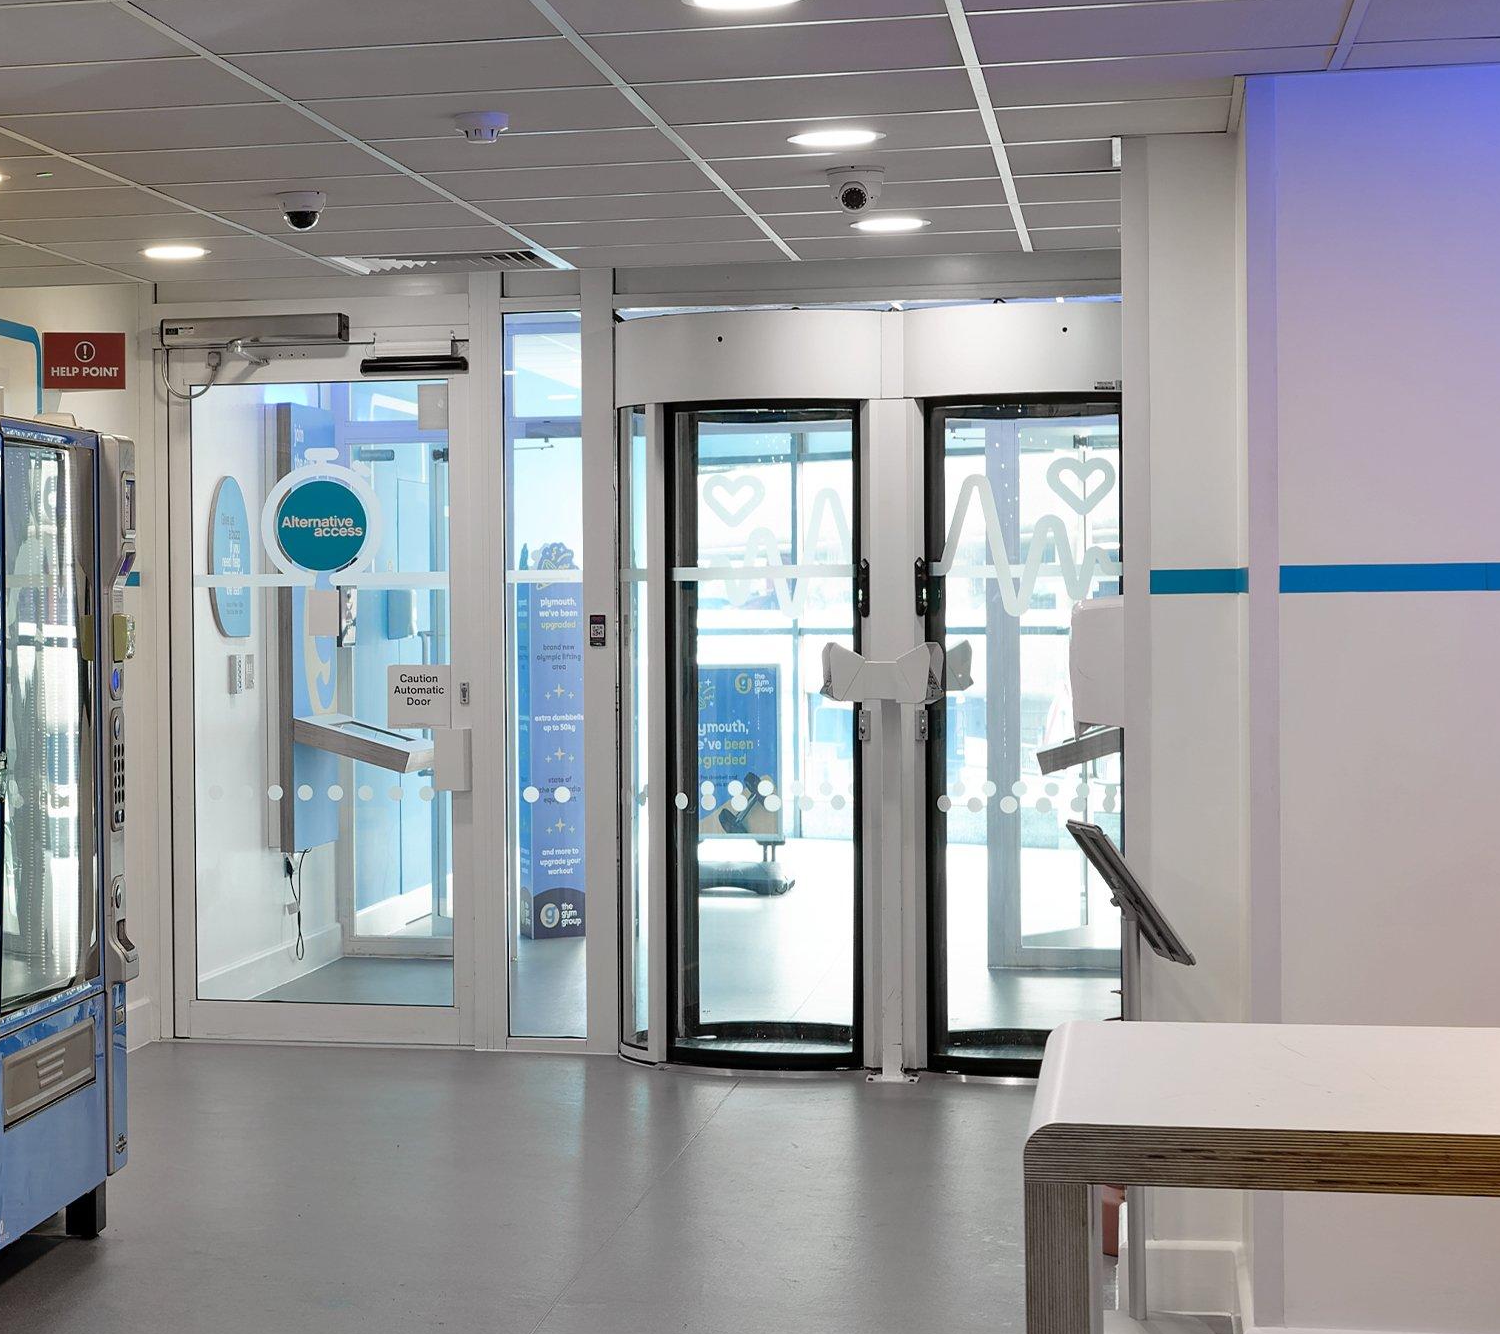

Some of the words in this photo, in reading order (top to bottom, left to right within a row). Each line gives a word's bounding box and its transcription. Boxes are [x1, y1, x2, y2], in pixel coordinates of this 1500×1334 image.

[50, 366, 80, 377] HELP
[82, 366, 119, 377] POINT
[281, 515, 354, 528] Alternative
[313, 527, 363, 537] access
[540, 597, 577, 608] plymouth,
[539, 609, 559, 618] we've
[560, 609, 578, 618] been
[540, 620, 577, 630] upgraded
[543, 643, 561, 651] brand
[536, 653, 561, 662] olympic
[399, 673, 438, 683] Caution
[754, 672, 766, 680] the
[754, 679, 769, 687] gym
[393, 685, 445, 695] Automatic
[754, 686, 774, 695] group
[406, 697, 432, 706] Door
[534, 714, 551, 722] extra
[551, 713, 585, 722] dumbbells
[543, 725, 552, 733] up
[552, 724, 559, 732] to
[560, 724, 576, 733] 50kg
[697, 719, 749, 736] ymouth,
[697, 738, 722, 750] e've
[724, 739, 754, 750] been
[697, 754, 747, 769] graded
[542, 847, 554, 856] and
[572, 847, 579, 855] to
[540, 858, 566, 867] upgrade
[567, 857, 582, 866] your
[548, 867, 574, 875] workout
[561, 902, 573, 911] the
[561, 910, 577, 918] gym
[561, 918, 582, 928] group
